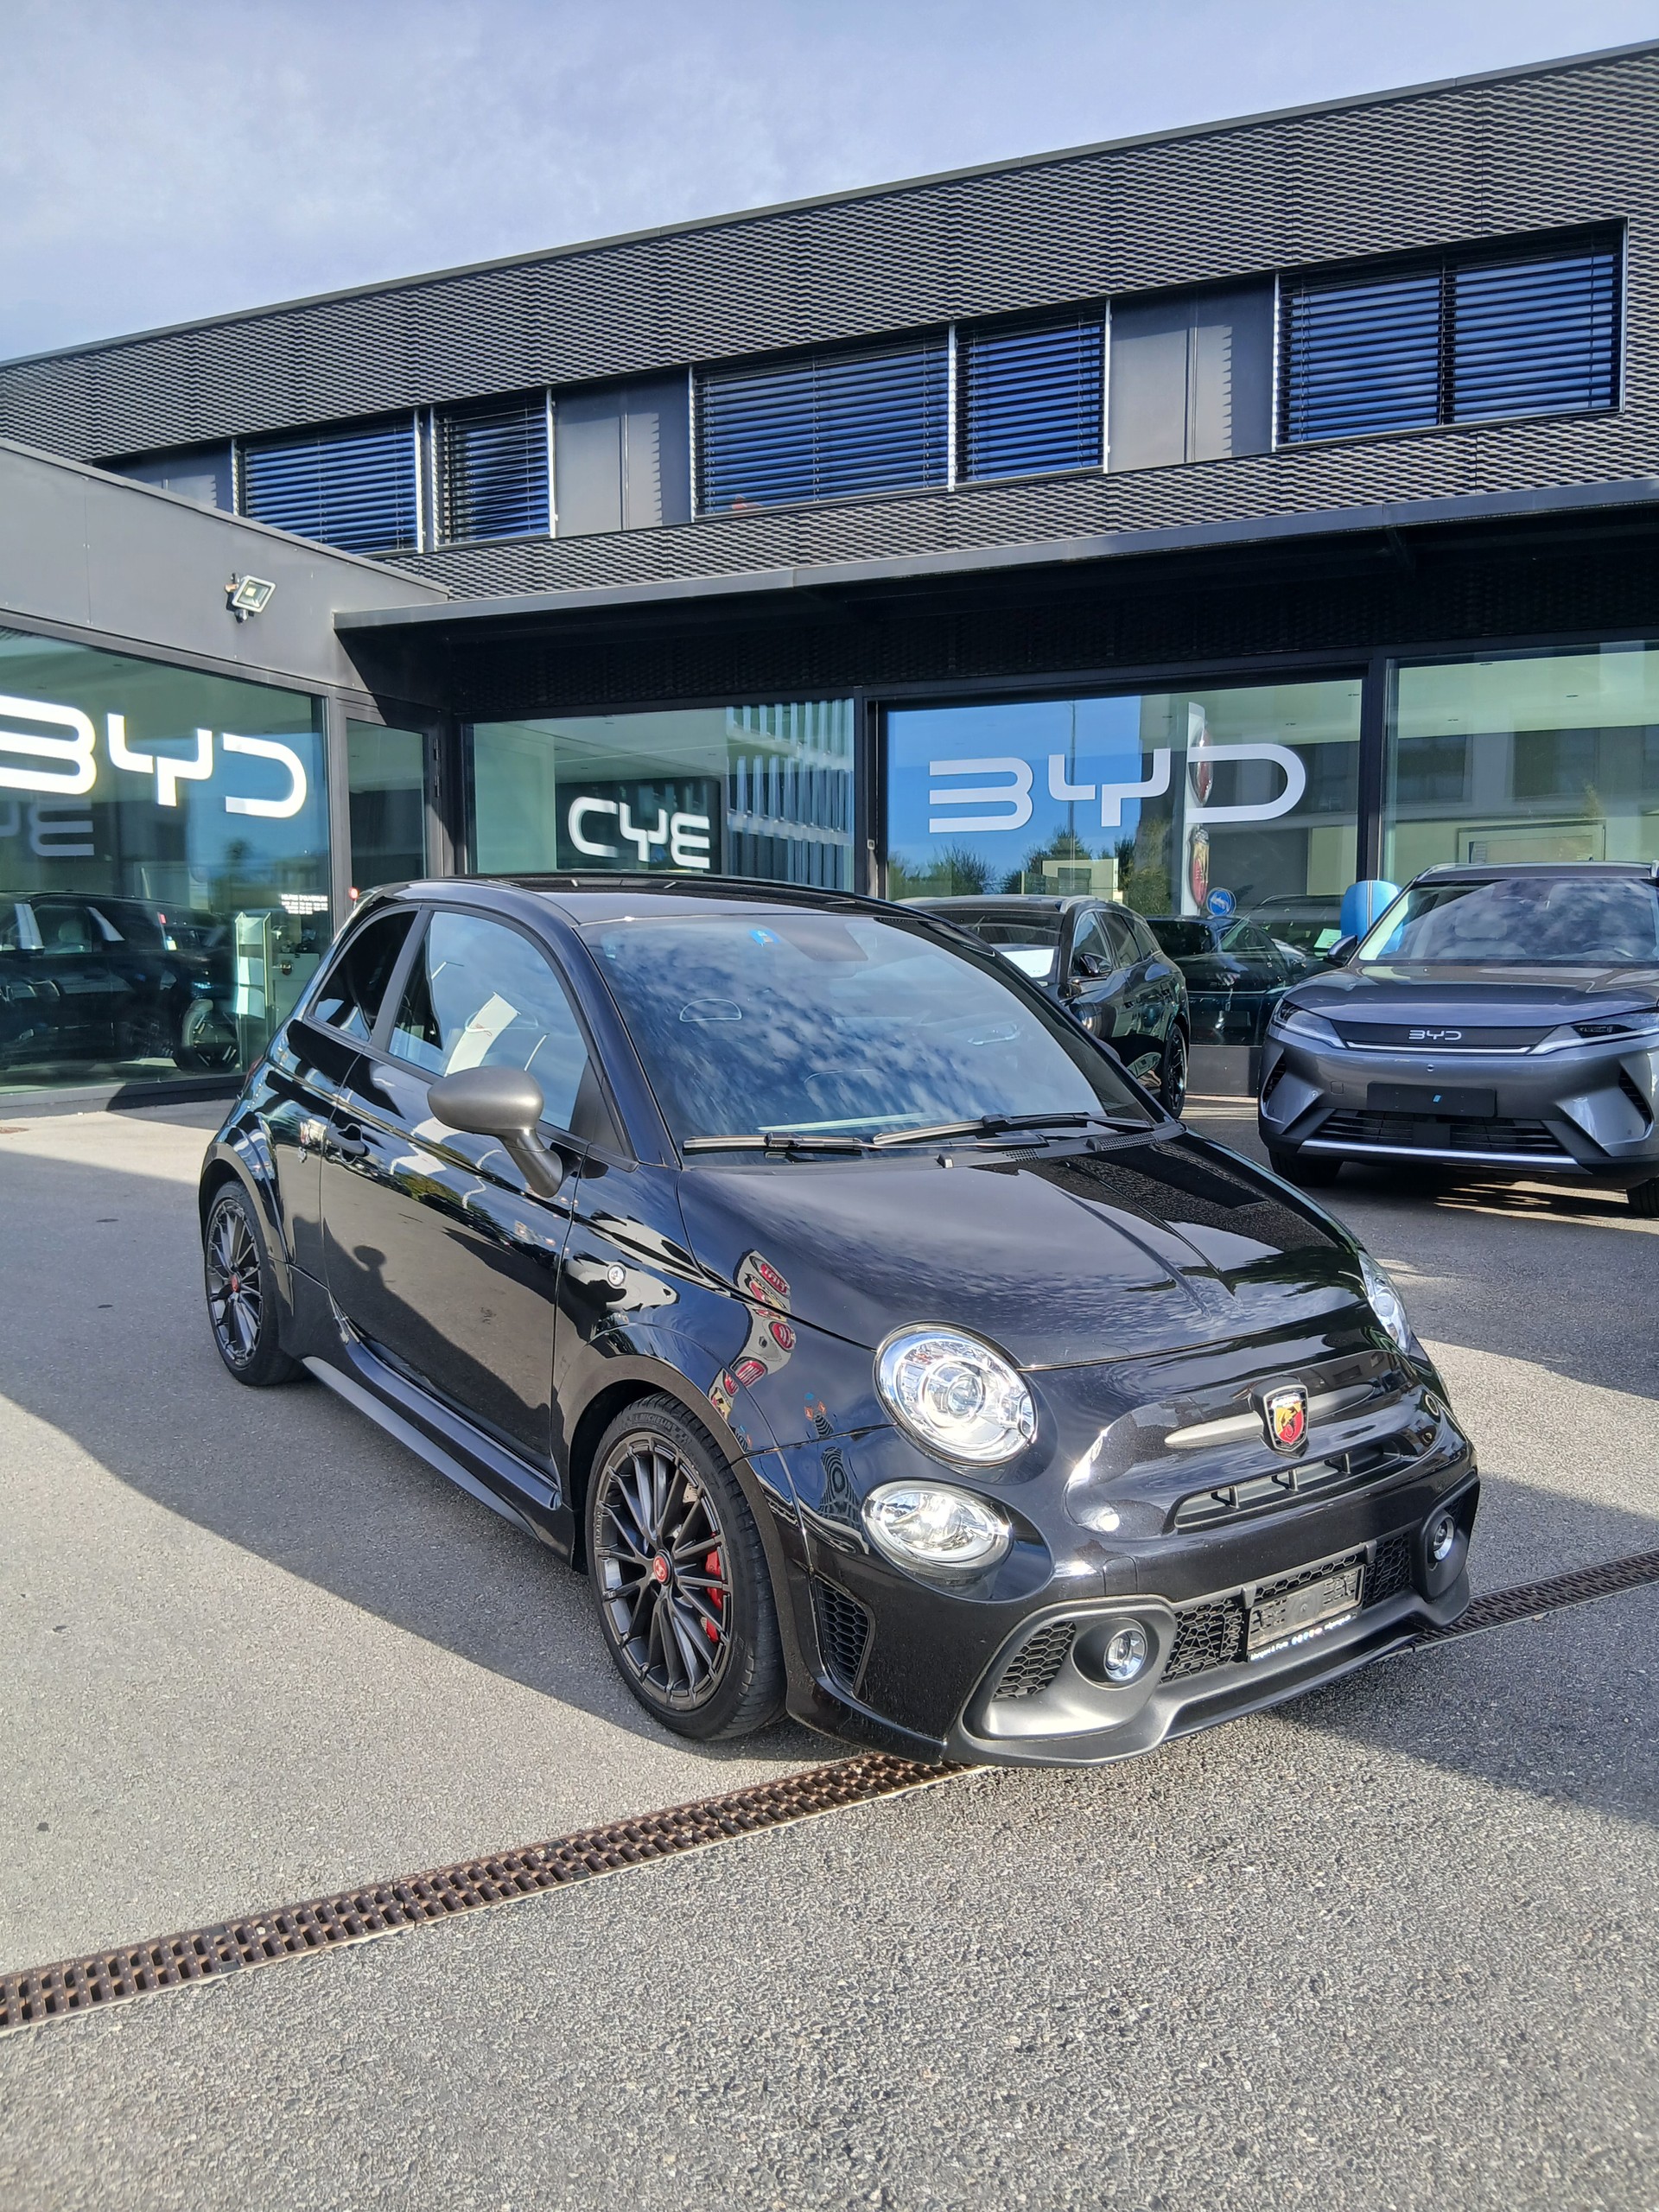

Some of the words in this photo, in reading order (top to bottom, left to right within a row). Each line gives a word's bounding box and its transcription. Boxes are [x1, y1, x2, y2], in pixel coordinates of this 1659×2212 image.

[0, 695, 307, 818] BYD
[929, 743, 1306, 833] BYD
[1408, 1030, 1462, 1041] BYD
